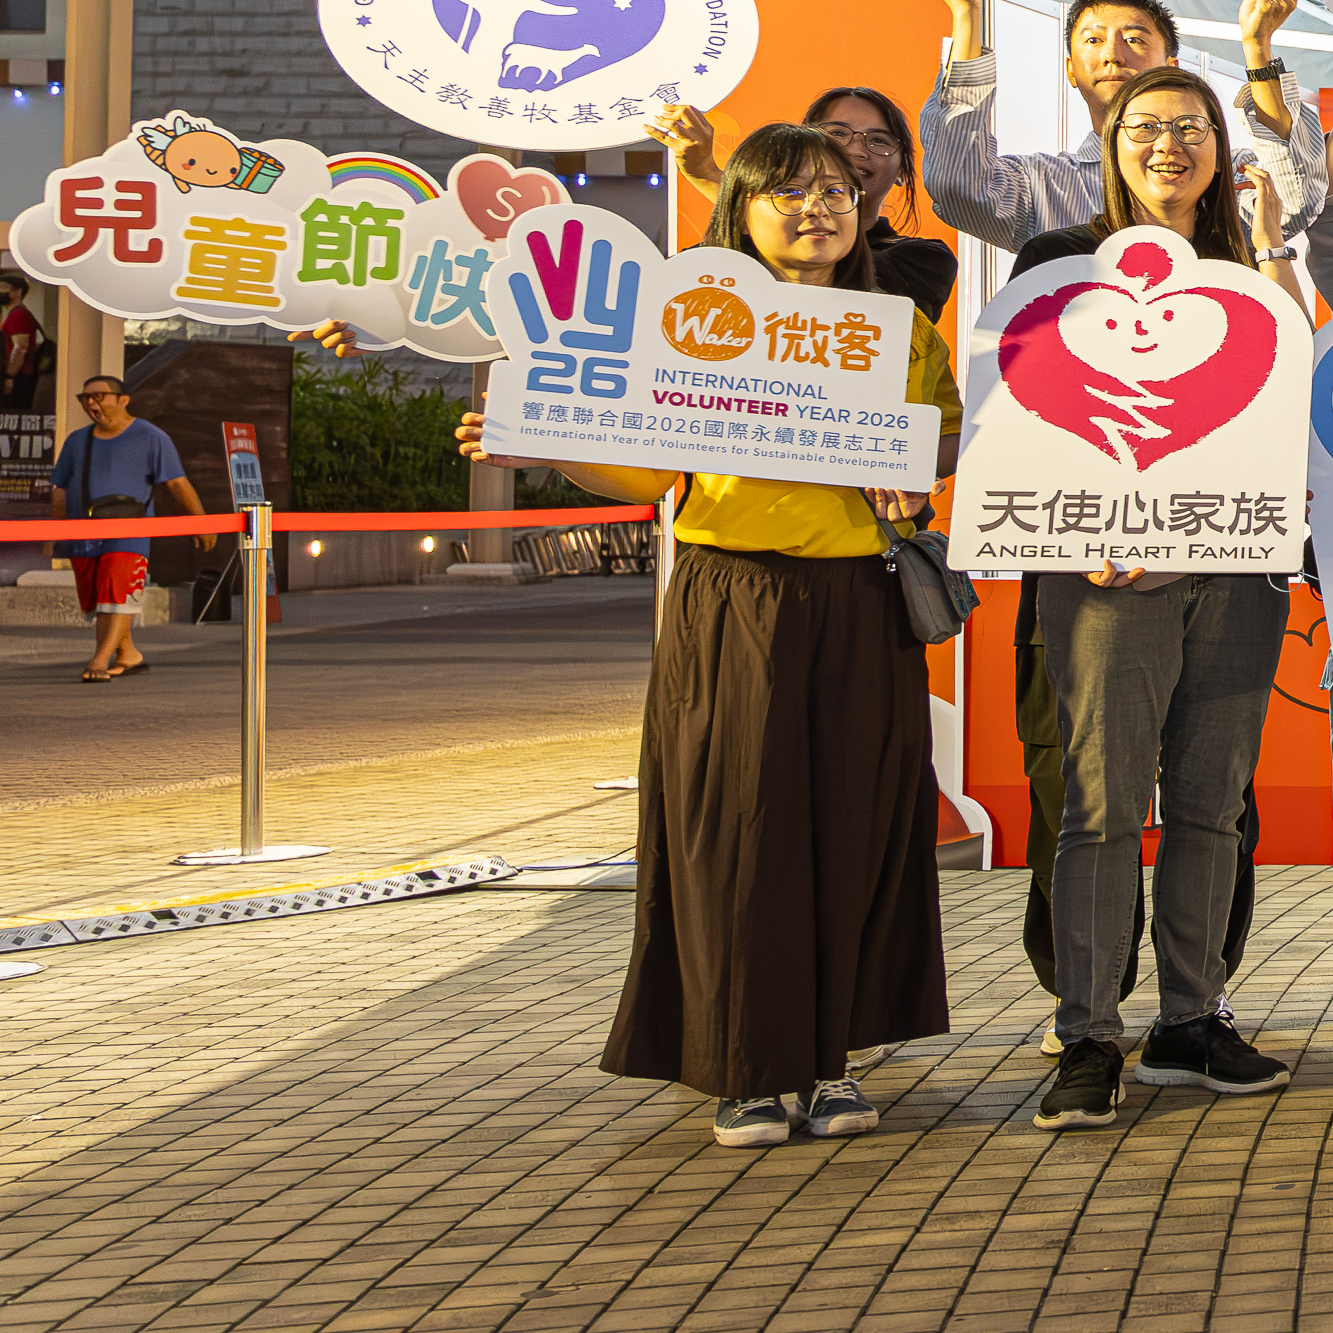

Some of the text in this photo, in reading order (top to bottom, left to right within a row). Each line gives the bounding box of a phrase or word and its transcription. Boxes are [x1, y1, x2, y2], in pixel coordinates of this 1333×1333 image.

[366, 39, 681, 125] 天主教善牧基金會
[53, 176, 497, 339] 兒童節快
[671, 303, 882, 372] Waker 微客
[526, 350, 630, 400] 26
[654, 368, 828, 400] INTERNATIONAL
[522, 401, 909, 456] 響應聯合國2026國際永續發展志工年
[652, 389, 909, 430] VOLUNTEER YEAR 2026
[520, 426, 908, 471] International Year of Volunteers for Sustainable Development
[976, 489, 1289, 537] 天使心家族
[976, 541, 1276, 560] ANGEL HEART FAMILY
